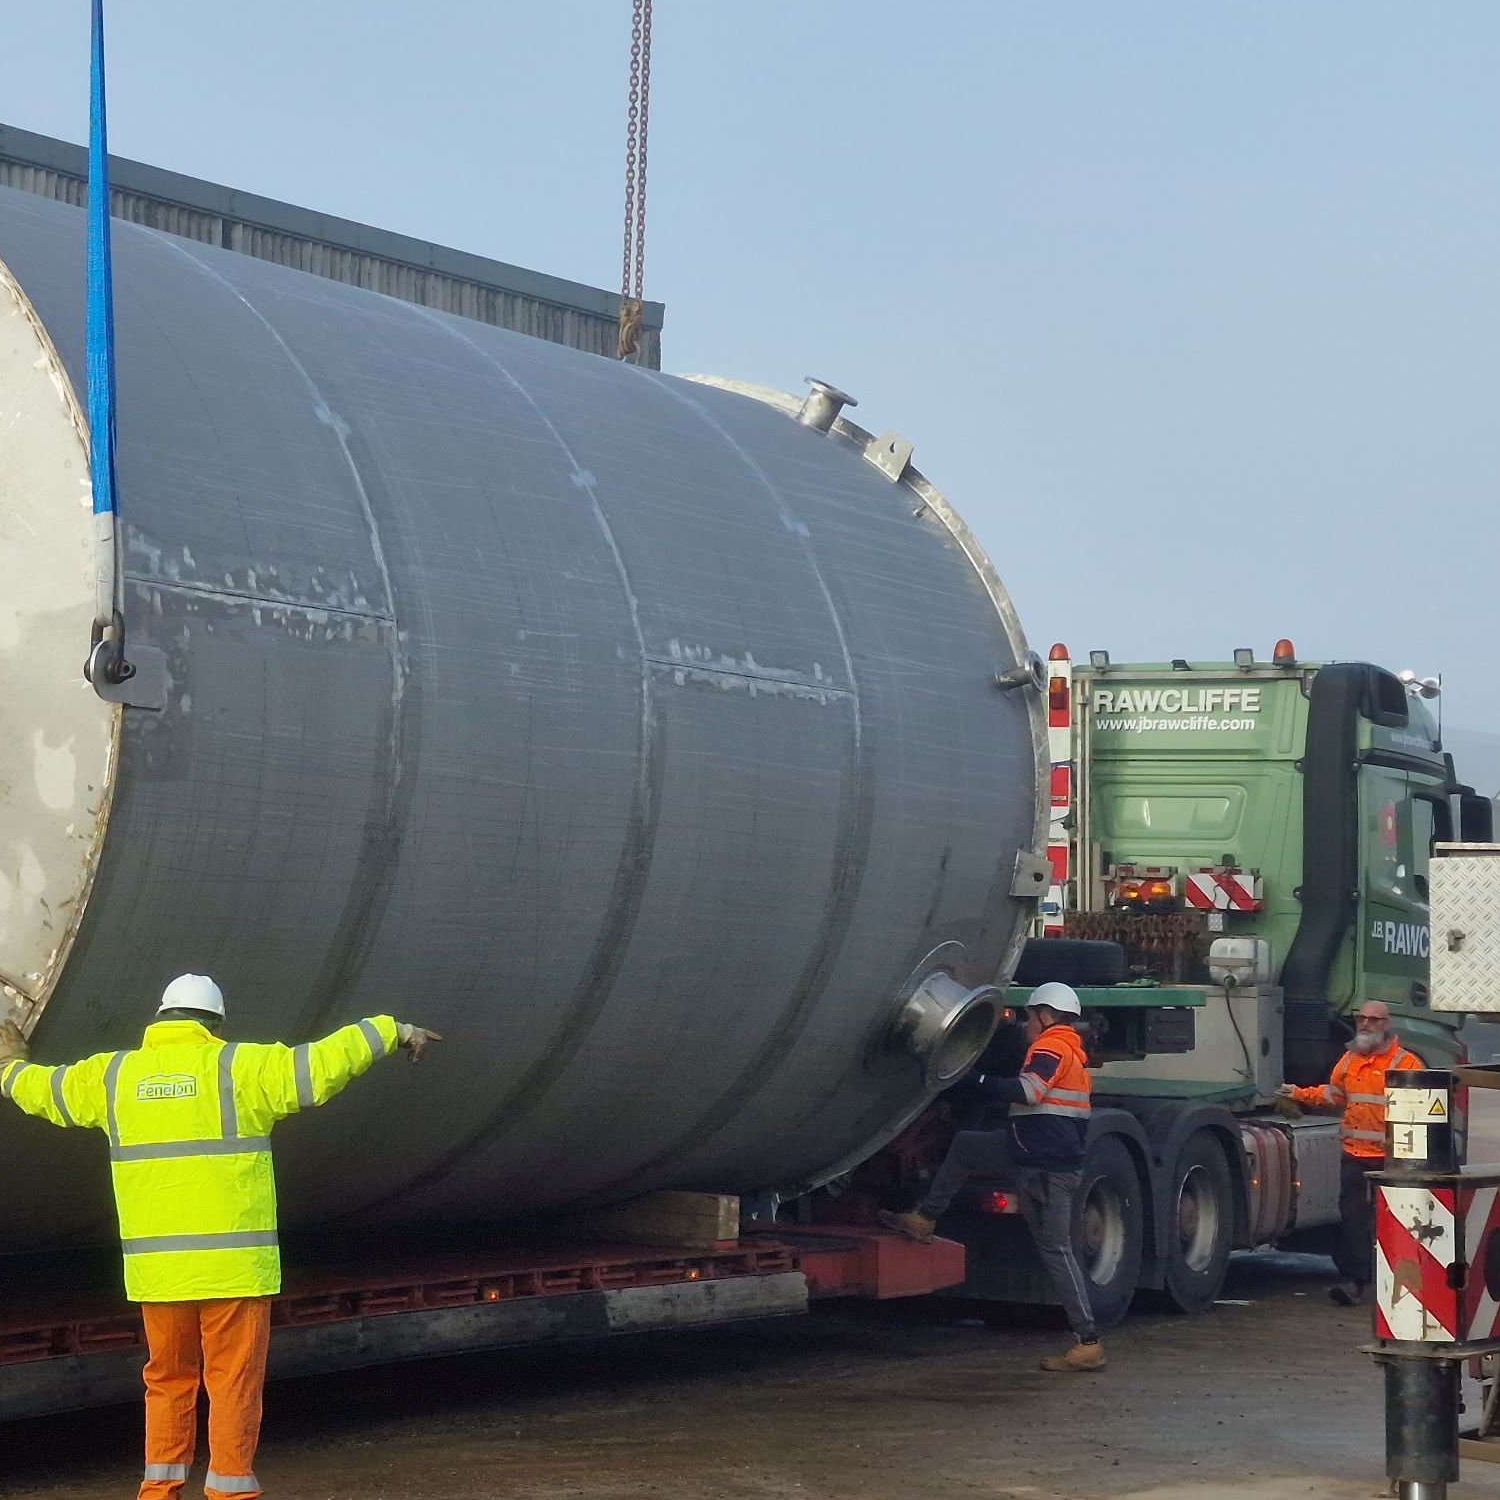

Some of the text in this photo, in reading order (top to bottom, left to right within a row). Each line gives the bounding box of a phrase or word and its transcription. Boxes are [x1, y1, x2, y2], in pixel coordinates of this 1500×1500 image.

[1093, 688, 1261, 713] RAWCLIFFE
[1096, 716, 1255, 734] www.jbrawcliffe.com
[136, 1083, 193, 1097] Fenelon
[1403, 1130, 1414, 1153] 1
